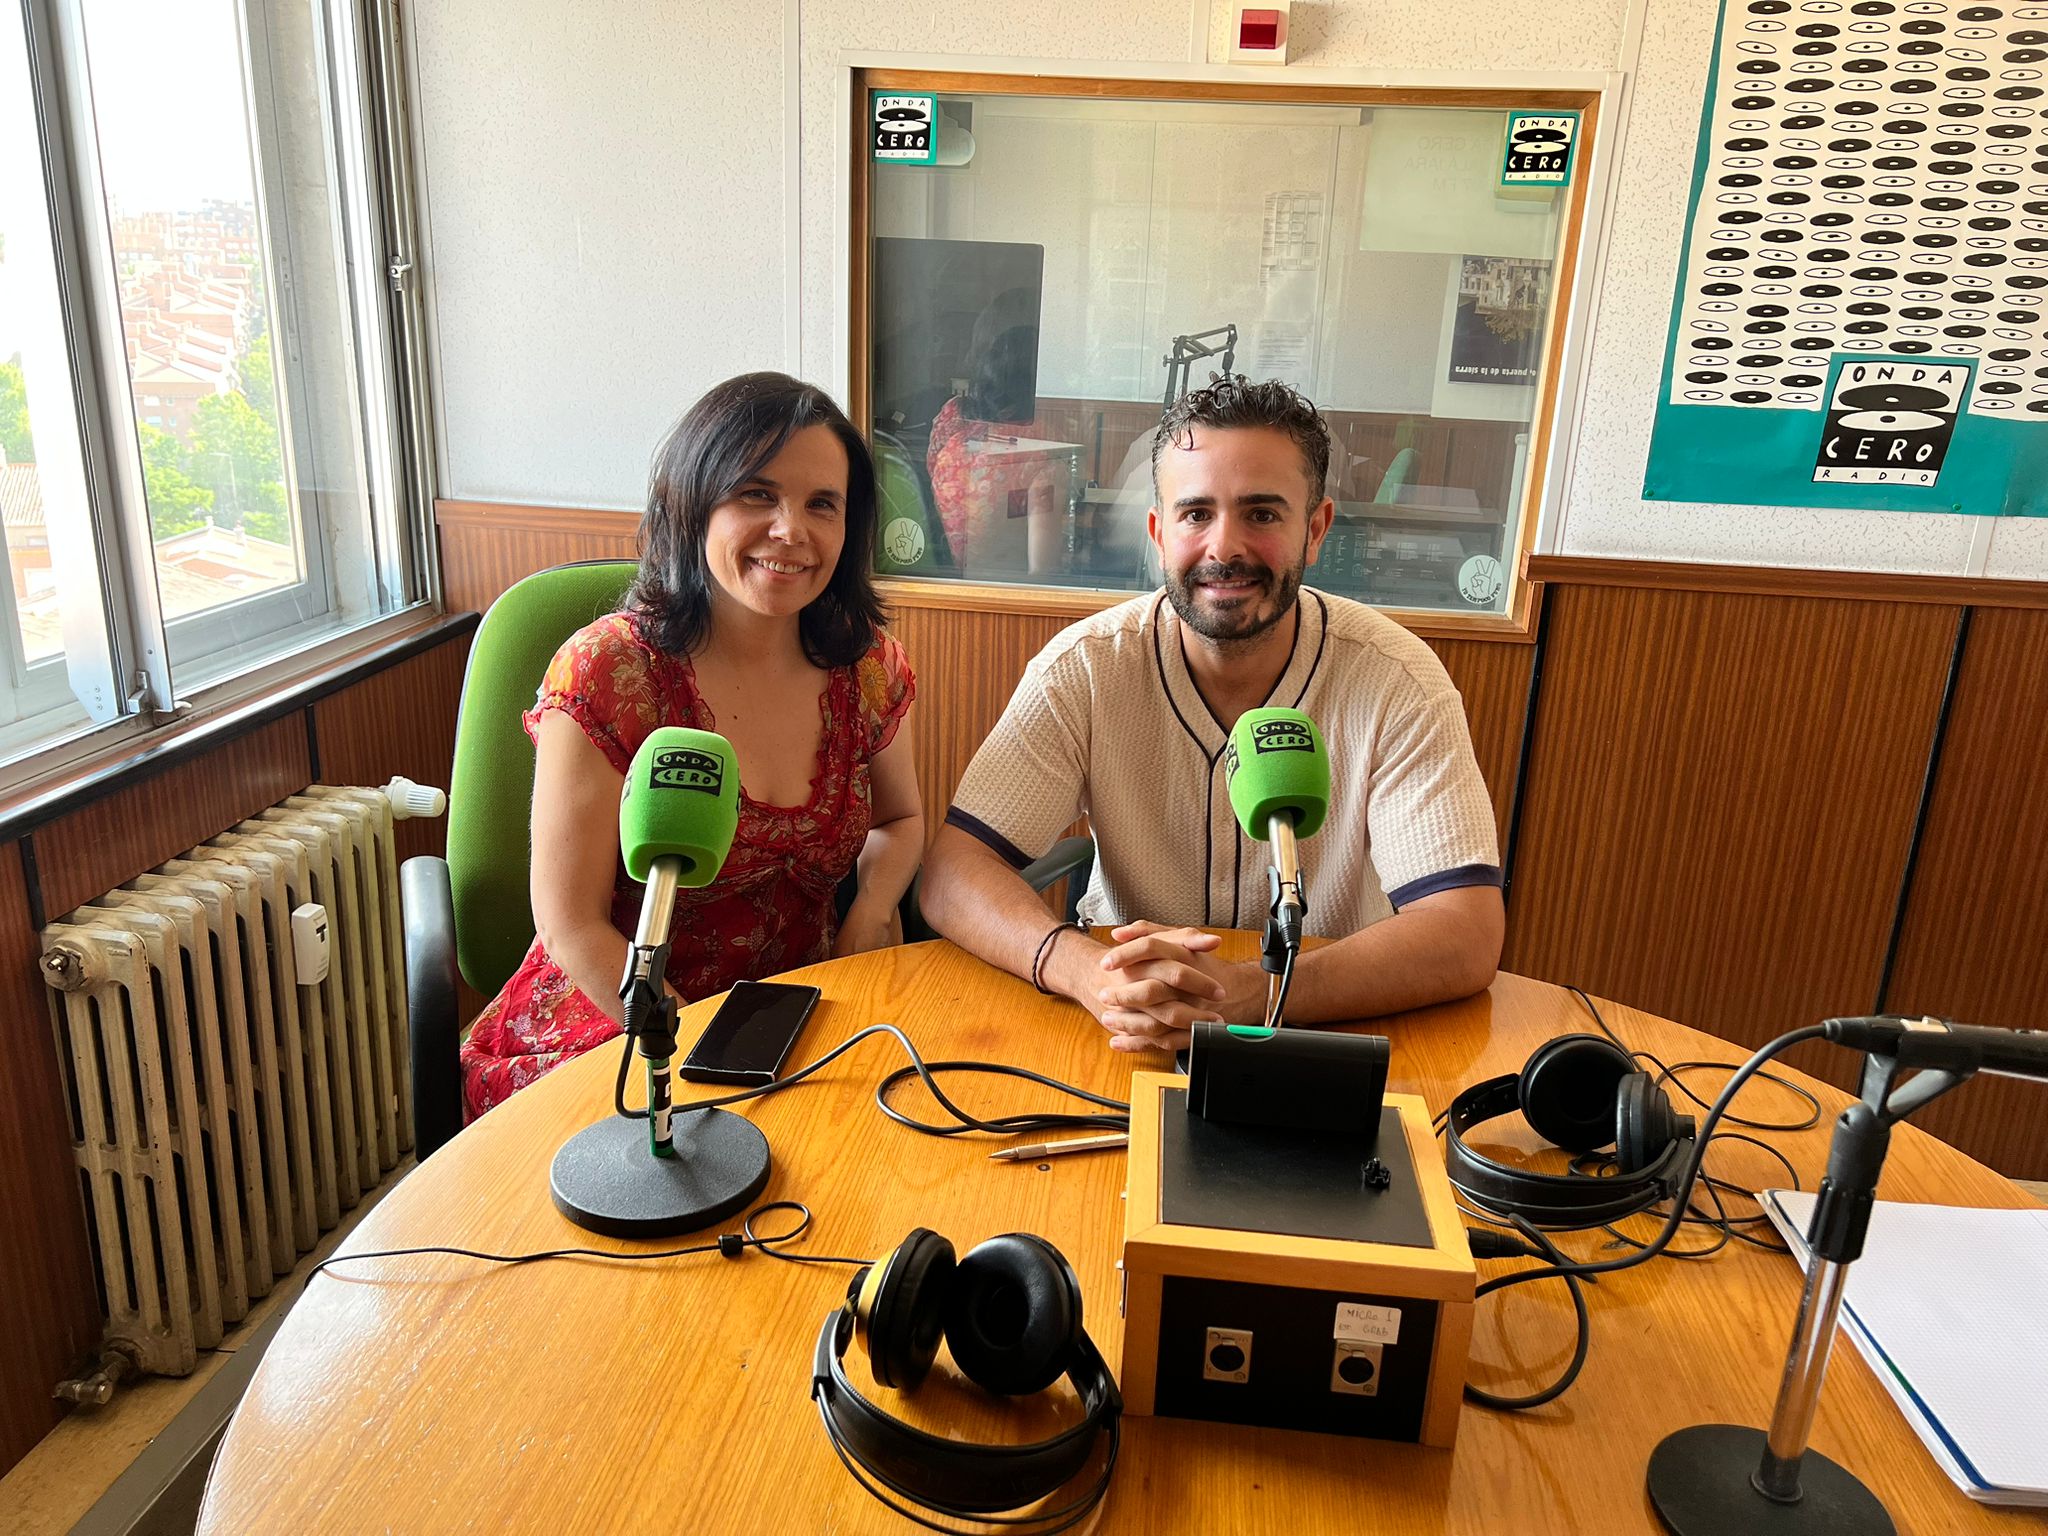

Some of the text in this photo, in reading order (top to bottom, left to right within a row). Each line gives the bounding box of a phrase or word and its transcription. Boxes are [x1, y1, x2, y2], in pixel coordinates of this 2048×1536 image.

[882, 99, 926, 107] ONDA
[1519, 120, 1568, 128] ONDA
[877, 133, 925, 148] CERO
[1508, 155, 1562, 169] CERO
[1455, 365, 1479, 374] sierra
[1481, 366, 1488, 375] la
[1490, 367, 1500, 376] de
[1501, 368, 1528, 376] puerta
[1852, 366, 1952, 384] ONDA
[1825, 436, 1934, 463] CERO
[1822, 469, 1929, 482] RADIO
[1260, 725, 1302, 733] ONDA
[1266, 736, 1305, 745] CERO
[662, 754, 713, 768] ONDA
[664, 769, 711, 784] CERO
